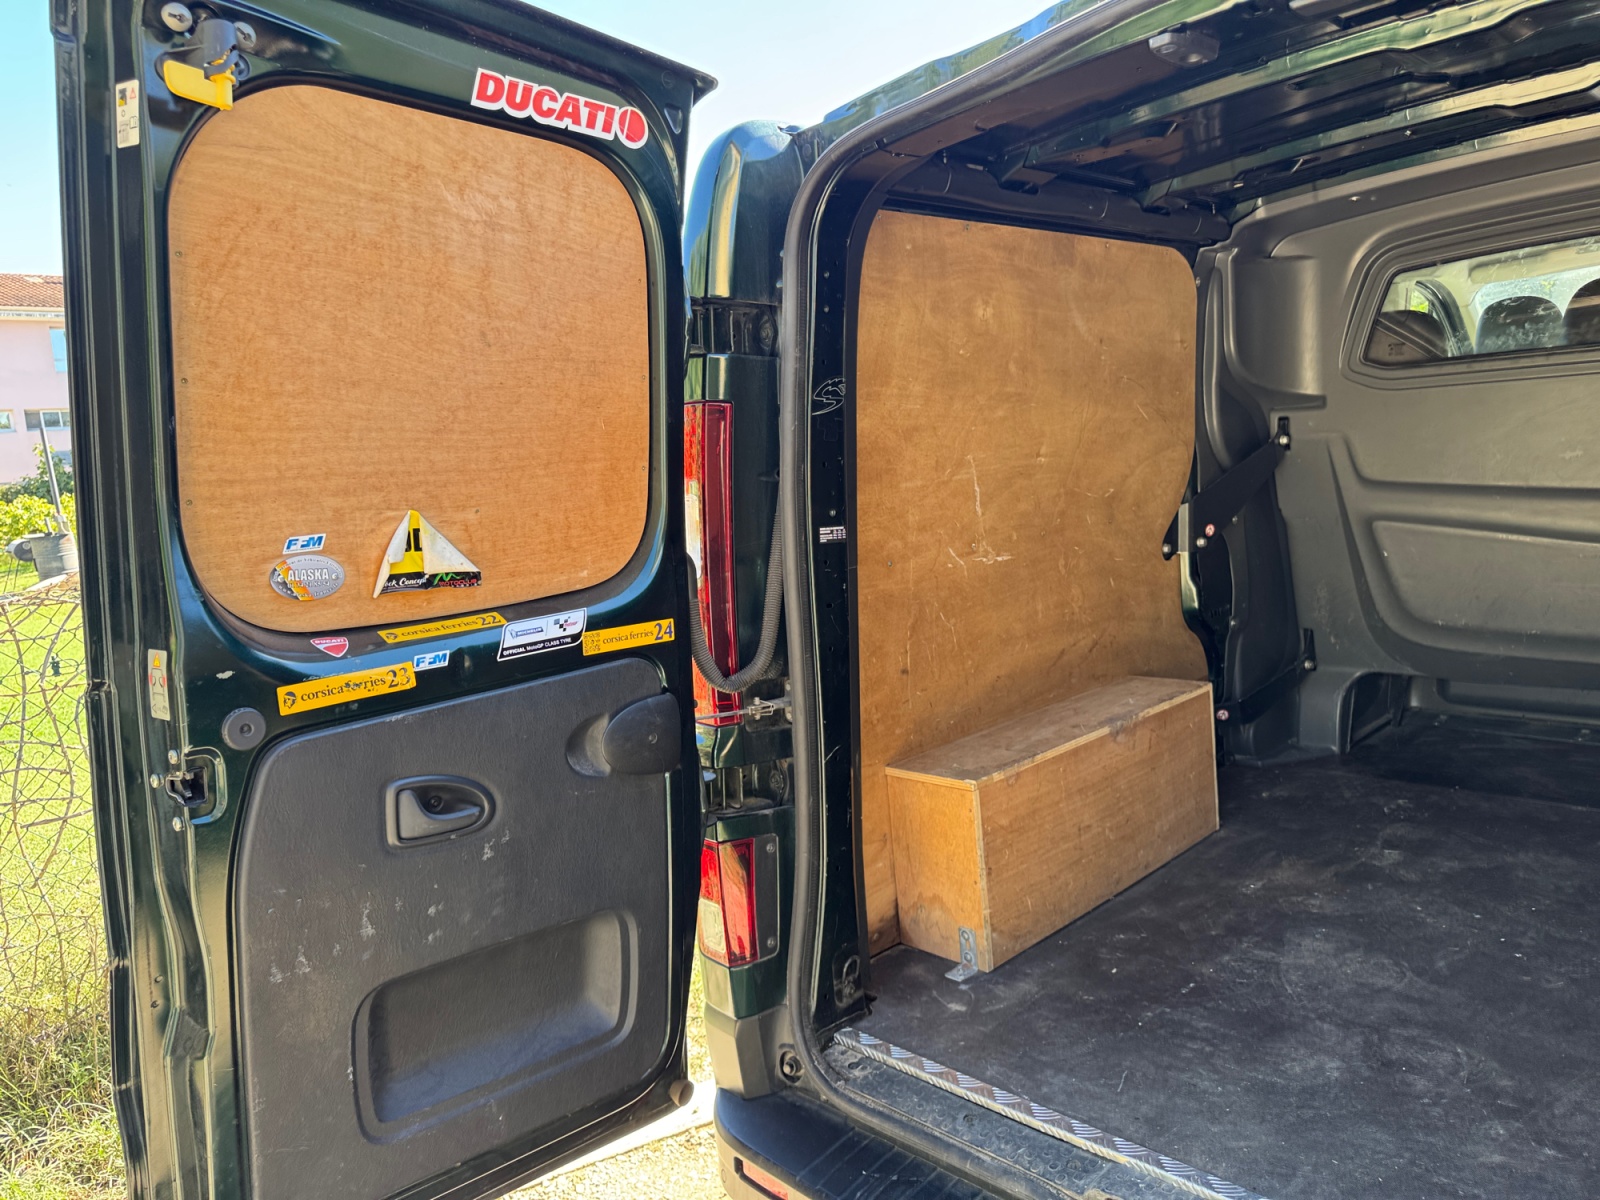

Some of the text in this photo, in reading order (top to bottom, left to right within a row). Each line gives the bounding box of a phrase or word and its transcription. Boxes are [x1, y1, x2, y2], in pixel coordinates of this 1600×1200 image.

[474, 71, 617, 135] DUCATI
[287, 568, 329, 581] ALASKA
[401, 614, 502, 637] corsica ferries 22
[602, 621, 674, 645] corsica ferries 24
[503, 646, 526, 656] OFFICIAL
[544, 639, 560, 648] CLASS
[300, 684, 345, 702] corsica
[386, 667, 412, 689] 23
